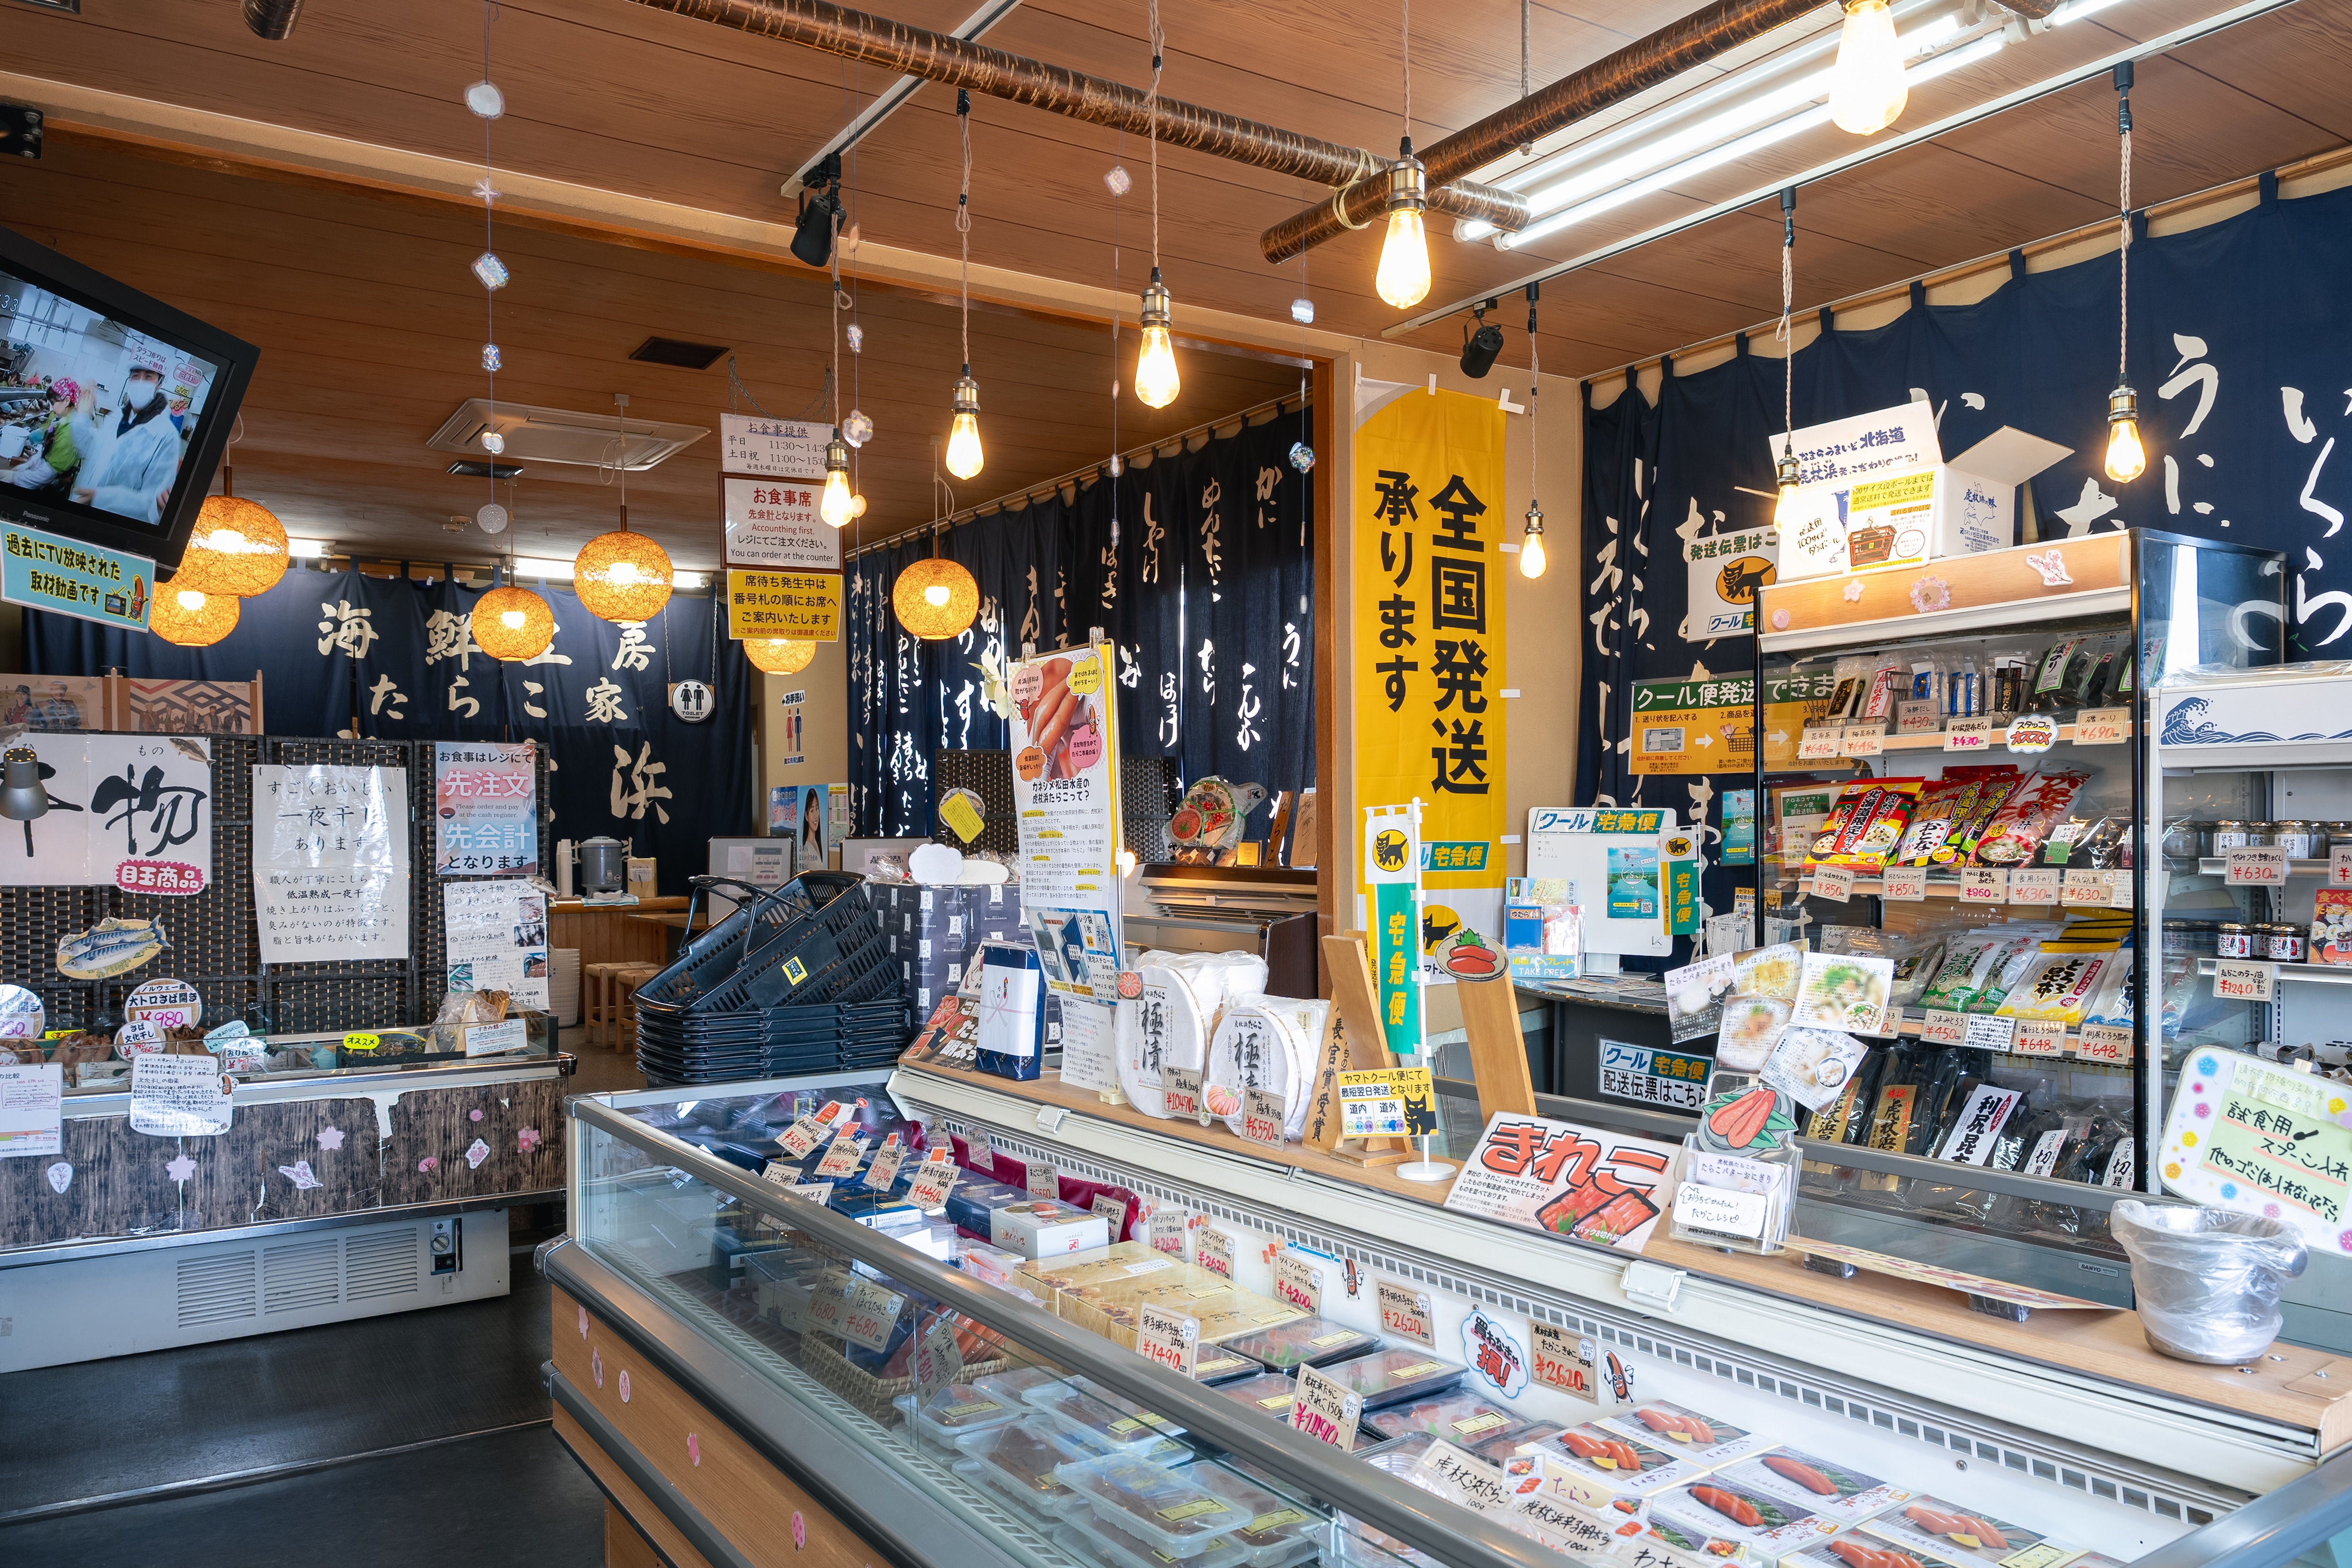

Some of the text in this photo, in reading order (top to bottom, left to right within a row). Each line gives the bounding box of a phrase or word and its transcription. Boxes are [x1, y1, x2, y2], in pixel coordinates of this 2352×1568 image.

[748, 422, 809, 438] お食事提供
[1860, 426, 1906, 448] 北海道
[2158, 333, 2231, 527] うに
[727, 435, 746, 446] 平日
[754, 487, 812, 507] お食事席
[799, 526, 815, 535] first.
[731, 549, 744, 557] You
[761, 550, 782, 559] order
[792, 551, 804, 560] the
[806, 553, 835, 562] counter.
[31, 570, 100, 605] 取材動画です
[745, 575, 826, 589] 席待ち発生中は
[1374, 470, 1419, 713] 承ります
[742, 611, 831, 625] ご案内いたします
[1711, 615, 1740, 632] クール
[318, 600, 656, 671] 海鮮房
[1428, 474, 1490, 795] 全国発送
[785, 692, 805, 705] お手洗い
[1642, 713, 1697, 723] 送り状を記入する
[1905, 706, 1931, 714] 海鮮だし
[2085, 714, 2116, 724] 磯のり
[439, 751, 532, 764] お食事はレジにて
[445, 770, 530, 797] 先注文
[1538, 812, 1657, 832] クール 宅急便
[445, 823, 531, 850] 先会計
[447, 855, 528, 869] となります
[1433, 844, 1484, 868] 宅急便
[121, 866, 200, 889] 目玉商品
[2018, 875, 2052, 883] 食用ふのり
[1676, 872, 1691, 924] 宅急便
[1388, 912, 1406, 1026] 宅急便
[1519, 968, 1541, 976] TAKE
[128, 993, 197, 1007] 大トロさば開き
[124, 1030, 154, 1043] 文化干し
[347, 1036, 375, 1046] オススメ
[1603, 1048, 1706, 1082] クール 宅急便
[1343, 1070, 1422, 1083] ヤマトクール便にて
[1349, 1101, 1397, 1115] 道内 道外
[2227, 1101, 2293, 1137] 試食用
[1480, 1121, 1671, 1200] きれこ
